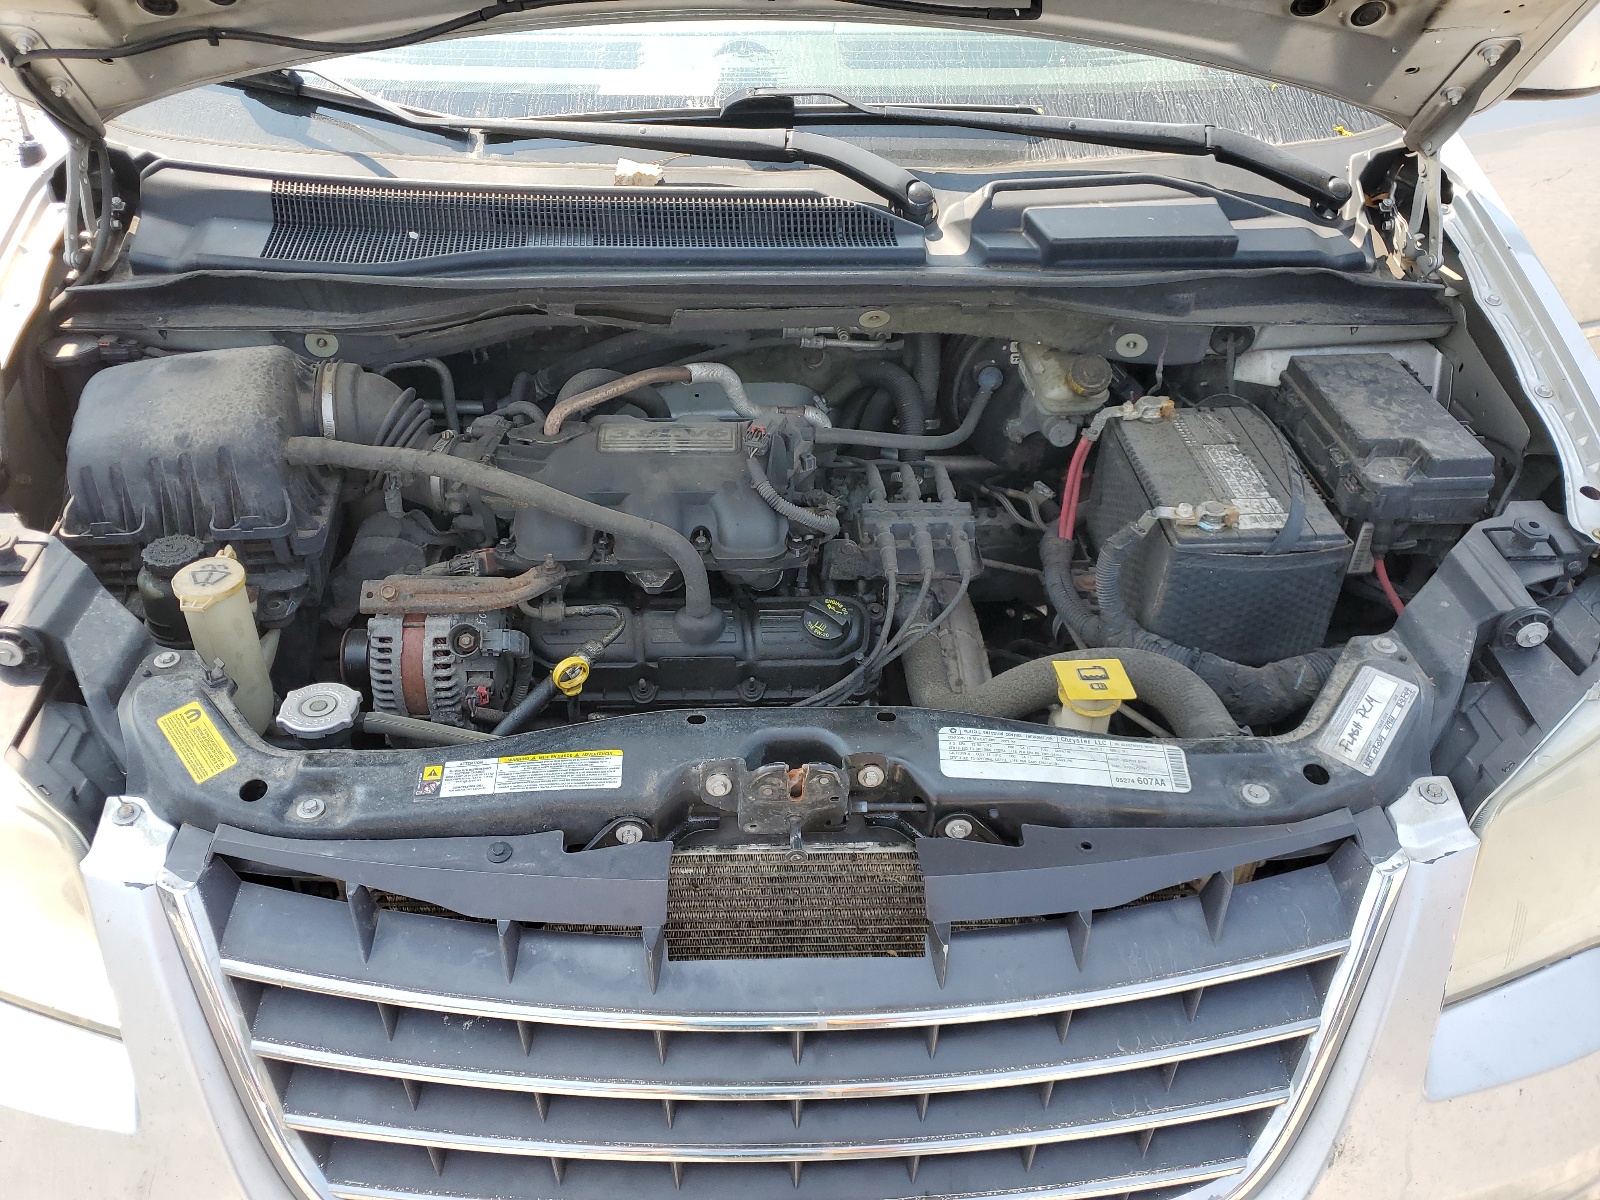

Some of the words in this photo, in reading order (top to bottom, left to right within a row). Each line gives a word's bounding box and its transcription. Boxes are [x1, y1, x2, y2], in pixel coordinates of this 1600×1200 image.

[1339, 721, 1363, 752] FLASH
[1356, 695, 1383, 720] PCM
[1137, 777, 1167, 787] 607AA
